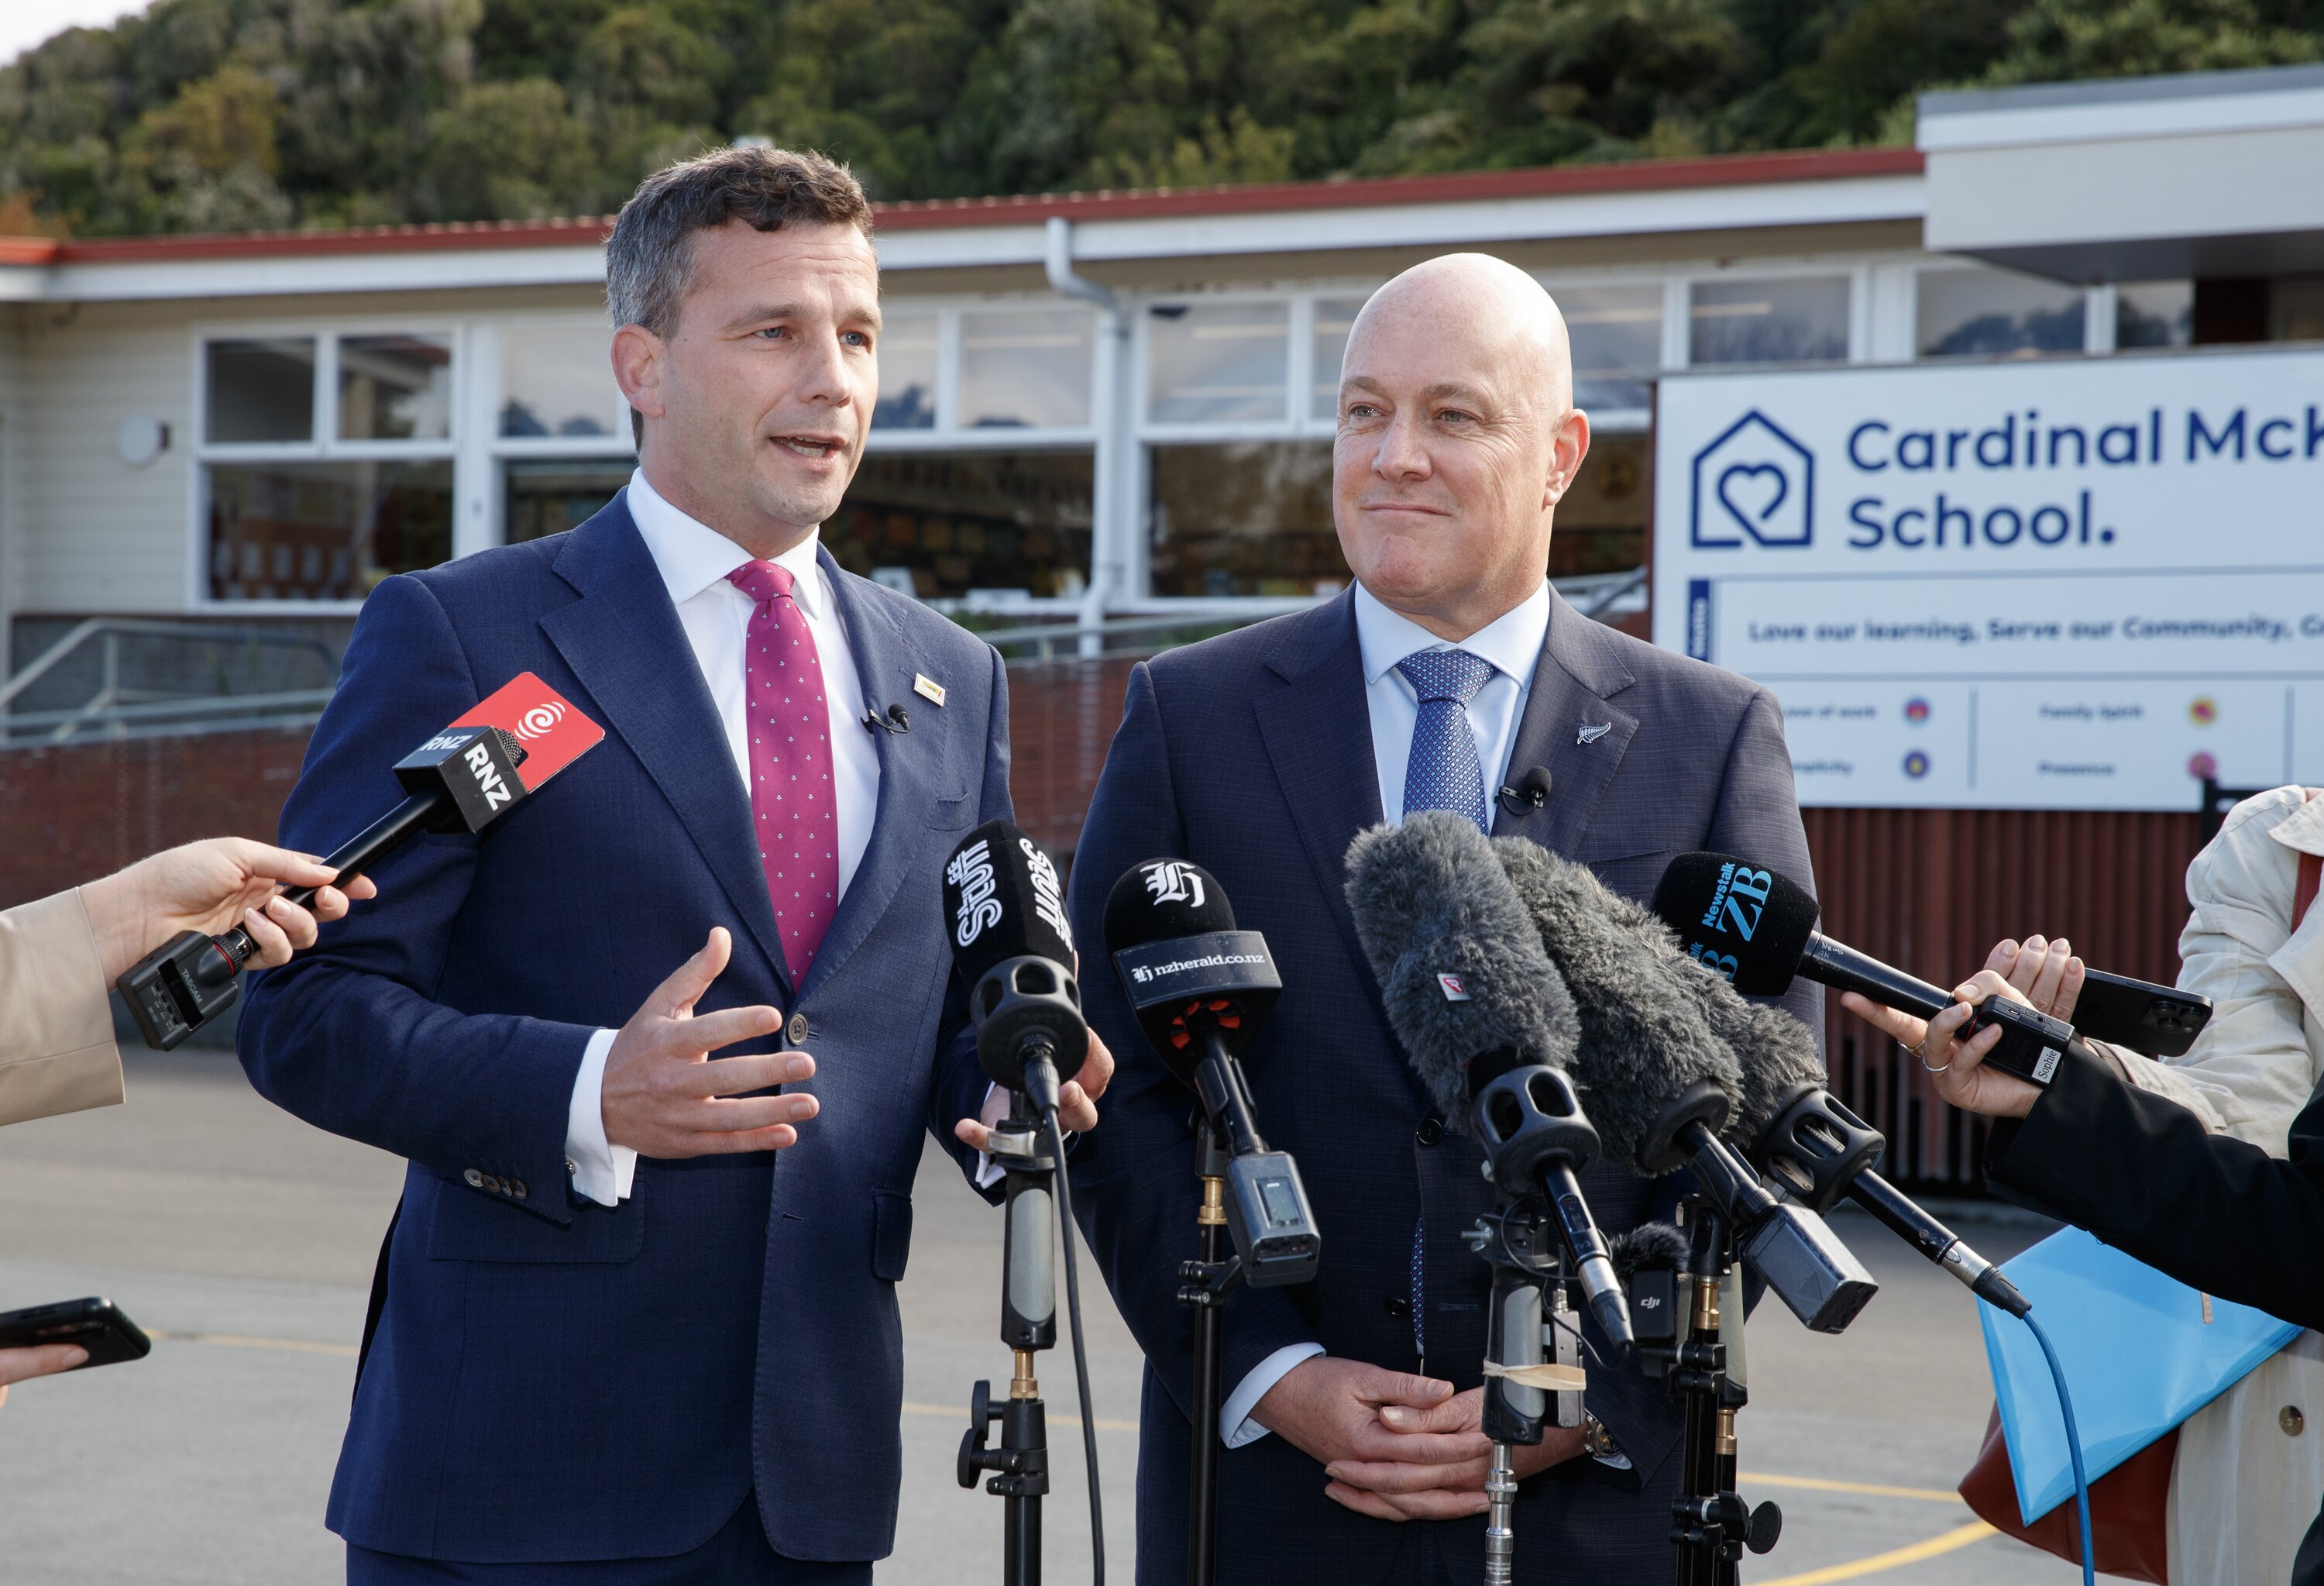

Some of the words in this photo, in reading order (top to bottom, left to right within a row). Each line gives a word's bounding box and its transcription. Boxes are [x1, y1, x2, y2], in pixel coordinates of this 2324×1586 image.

[1846, 408, 2161, 472] Cardinal
[1847, 487, 2117, 550] School.
[1748, 619, 1807, 642] Love
[1815, 623, 1857, 642] our
[1864, 615, 1981, 646] learning,
[1986, 618, 2061, 641] Serve
[2068, 621, 2114, 641] our
[2122, 611, 2294, 645] Community,
[418, 735, 473, 752] RNZ
[464, 742, 512, 811] RNZ
[947, 839, 1002, 948] Stuff
[1701, 862, 1736, 928] Newstalk
[1715, 866, 1772, 942] ZB
[180, 968, 204, 1005] TASCAM
[1153, 954, 1266, 977] nzherald.co.nz
[2037, 1050, 2058, 1079] Sophie
[1640, 1296, 1661, 1309] dji
